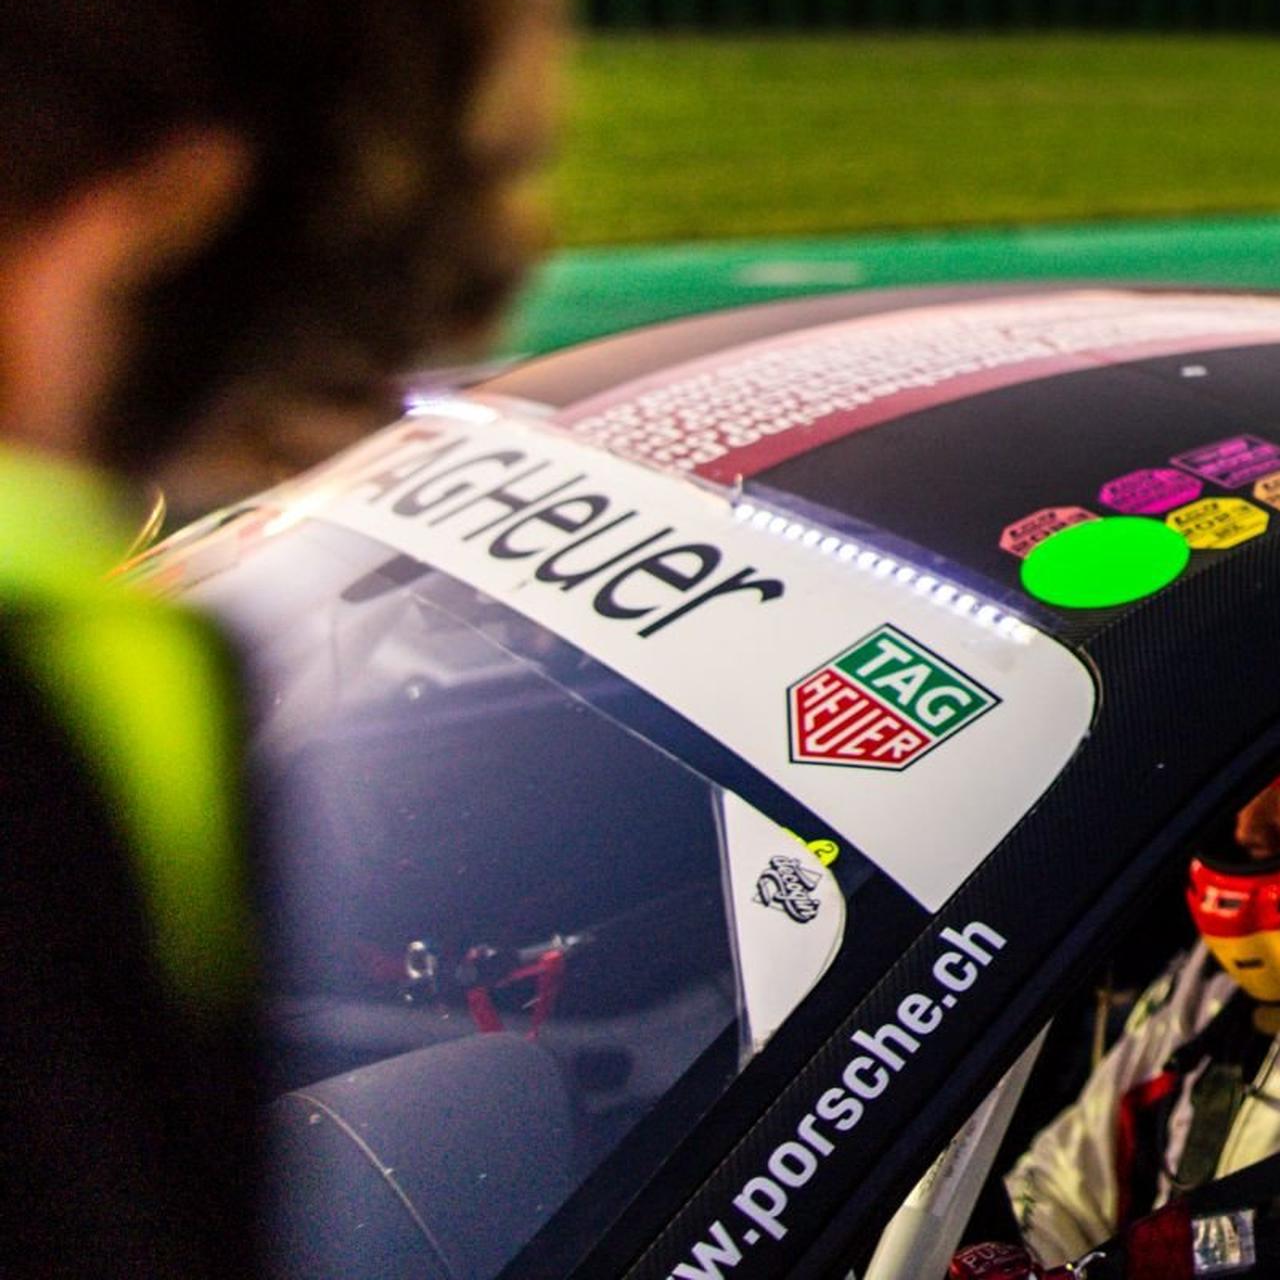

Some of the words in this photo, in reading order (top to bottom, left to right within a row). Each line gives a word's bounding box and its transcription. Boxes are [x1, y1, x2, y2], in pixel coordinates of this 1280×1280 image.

[803, 672, 922, 759] HEUER
[855, 637, 973, 728] TAG
[665, 921, 1007, 1280] w.porsche.ch
